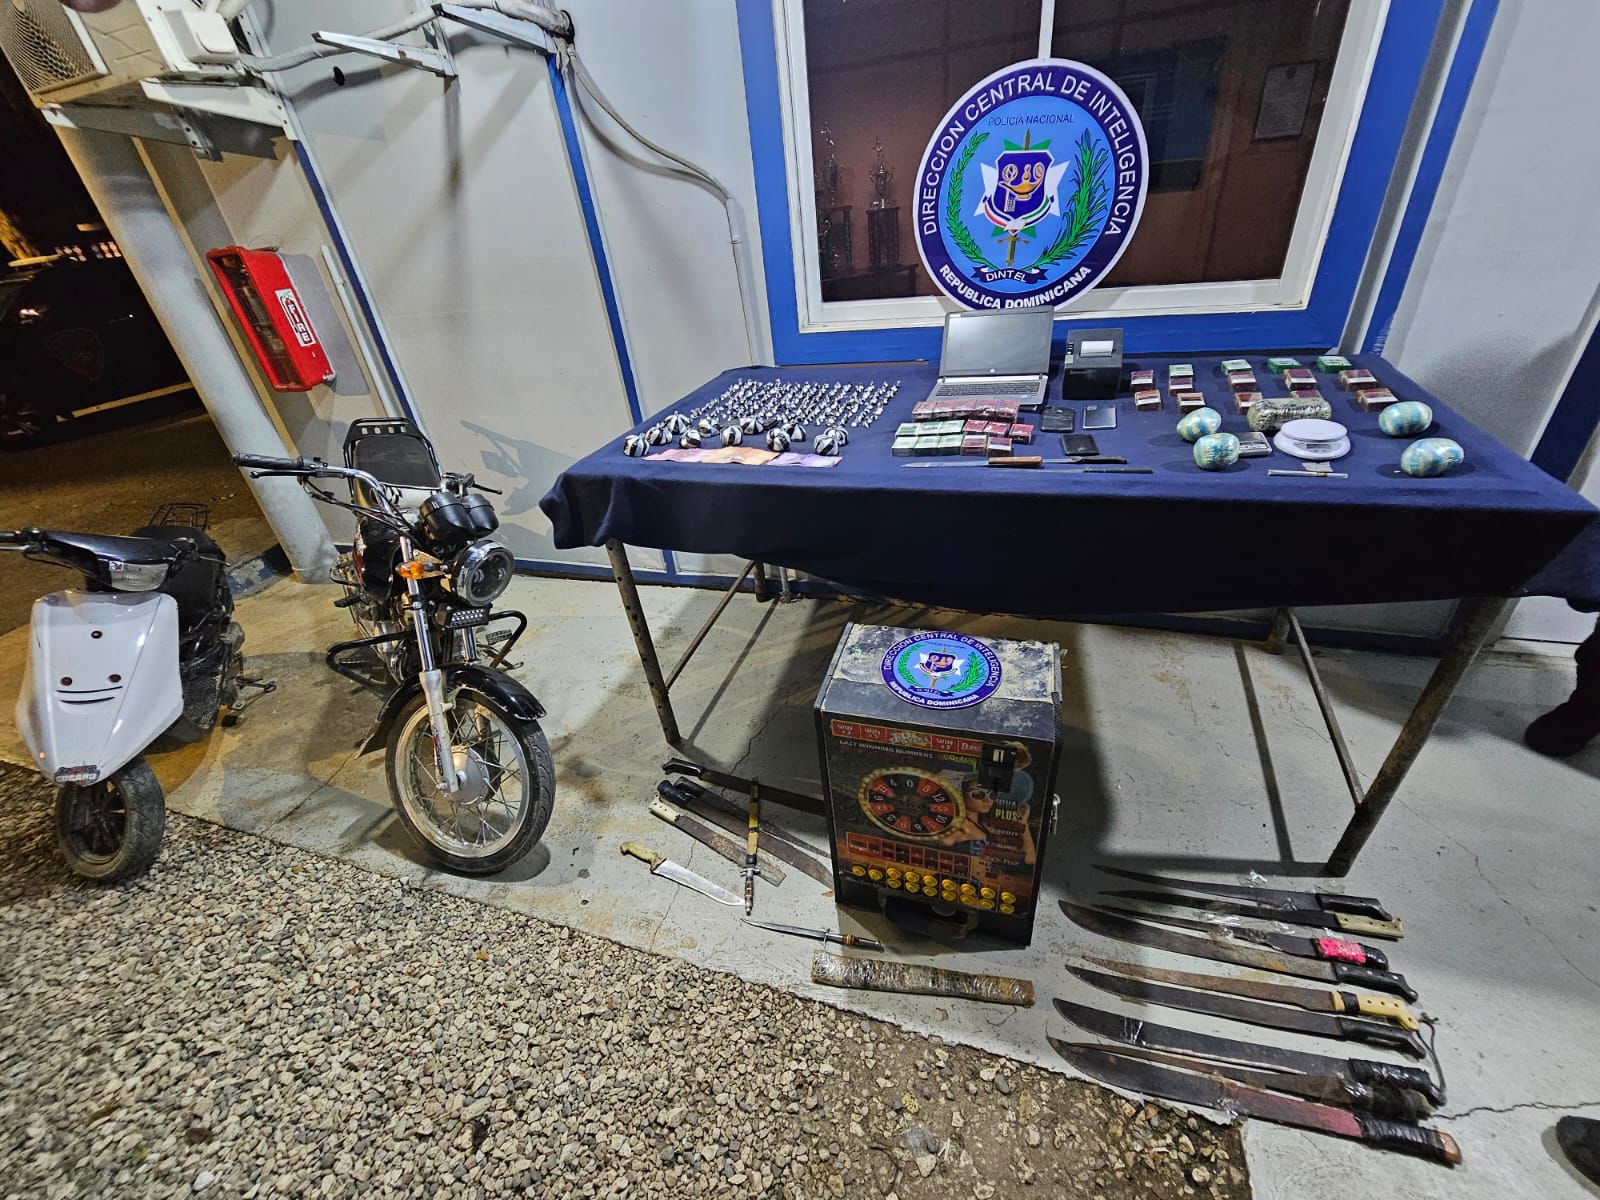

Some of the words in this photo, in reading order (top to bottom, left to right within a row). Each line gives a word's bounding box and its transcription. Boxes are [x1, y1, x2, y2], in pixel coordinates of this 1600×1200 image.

[988, 116, 1024, 126] POLICIA
[1026, 113, 1075, 124] NACIONAL
[923, 120, 965, 235] DIRECCION
[965, 72, 1055, 121] CENTRAL
[1060, 74, 1091, 101] DE
[1088, 90, 1136, 236] INTELIGENCIA
[985, 269, 1027, 283] DINTEL
[939, 264, 1001, 309] REPUBLICA
[1005, 265, 1092, 309] DOMINICANA
[287, 303, 311, 342] FIRE
[883, 638, 913, 670] DIRECCION
[914, 632, 960, 642] CENTRAL
[960, 636, 975, 645] DE
[974, 641, 1000, 687] INTELIGENCIA
[927, 694, 980, 706] DOMINICANA
[839, 740, 857, 748] LAST
[858, 743, 894, 753] WINNING
[895, 748, 934, 759] NUMBERS
[936, 738, 953, 746] WIN
[995, 808, 1018, 821] PLUS
